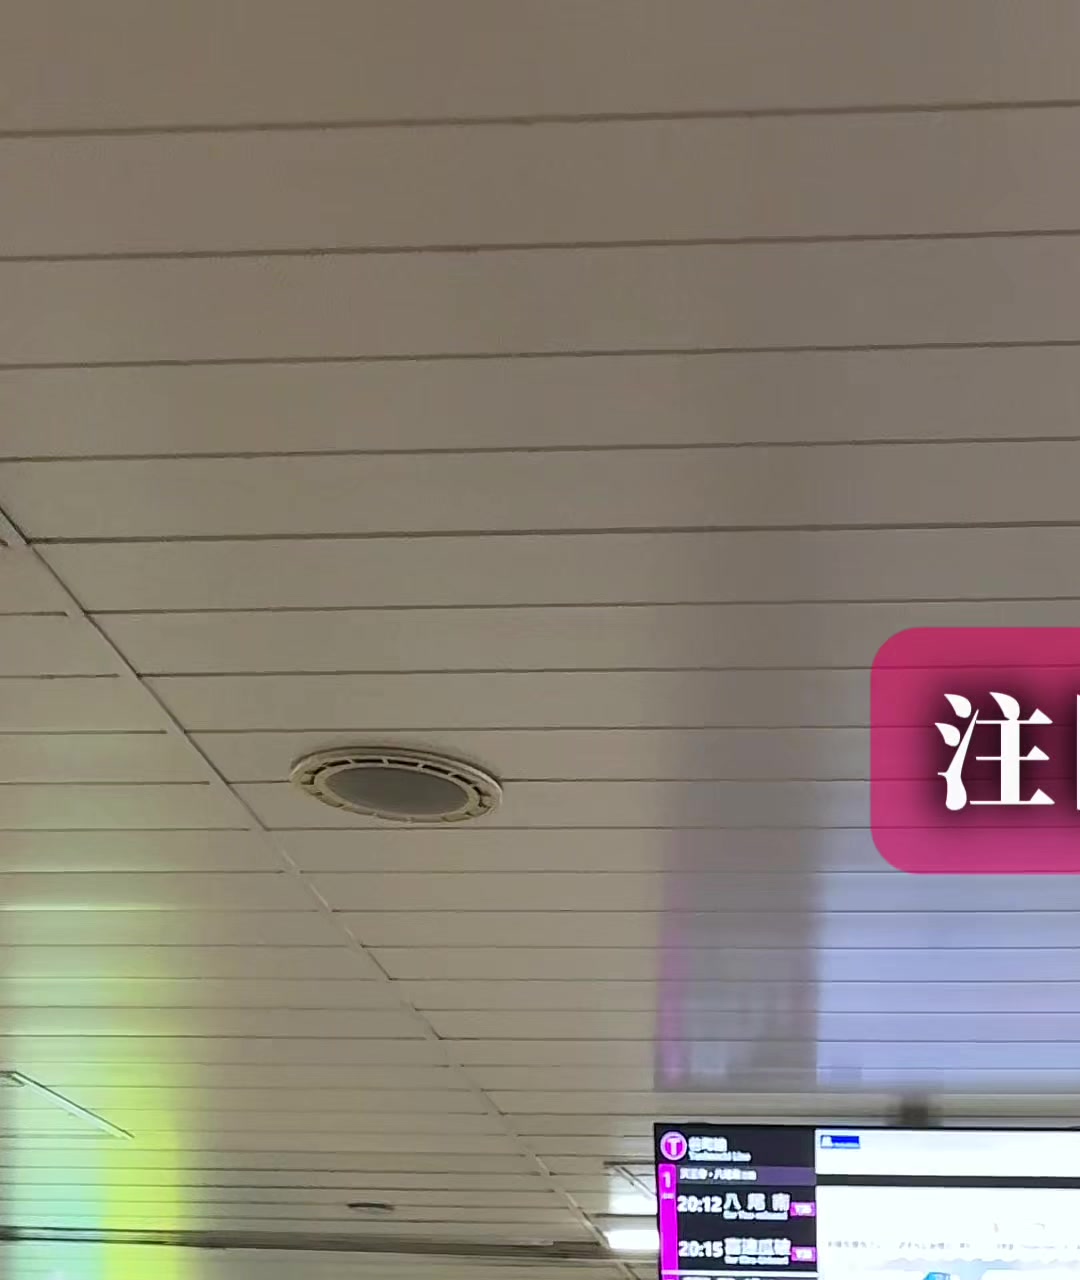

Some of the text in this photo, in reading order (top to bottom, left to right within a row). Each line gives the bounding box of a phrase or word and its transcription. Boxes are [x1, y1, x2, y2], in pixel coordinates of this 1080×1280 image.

[662, 1171, 672, 1188] 1
[677, 1195, 723, 1213] 20:12
[678, 1240, 724, 1258] 20:15
